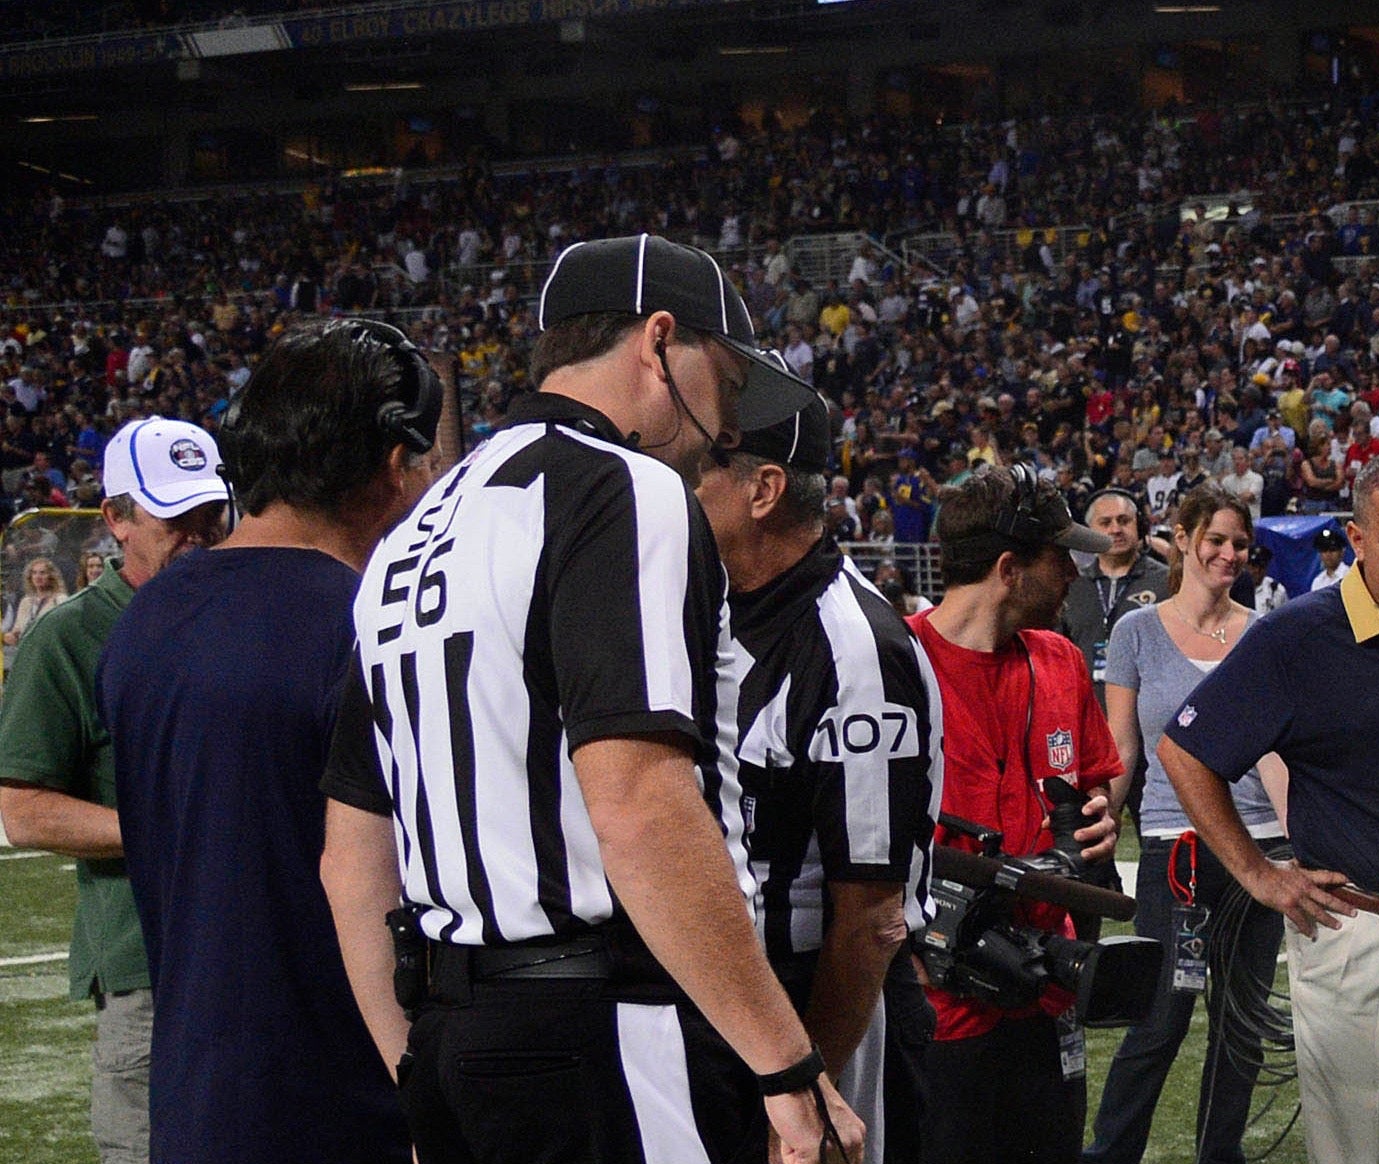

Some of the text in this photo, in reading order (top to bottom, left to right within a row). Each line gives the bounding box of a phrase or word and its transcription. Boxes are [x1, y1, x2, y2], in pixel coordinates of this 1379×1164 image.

[330, 17, 392, 42] ELROY
[401, 3, 528, 35] CRAZYLEGS
[408, 495, 463, 553] SJ
[377, 537, 457, 646] 56
[817, 711, 908, 757] 107
[1051, 746, 1072, 764] NFL
